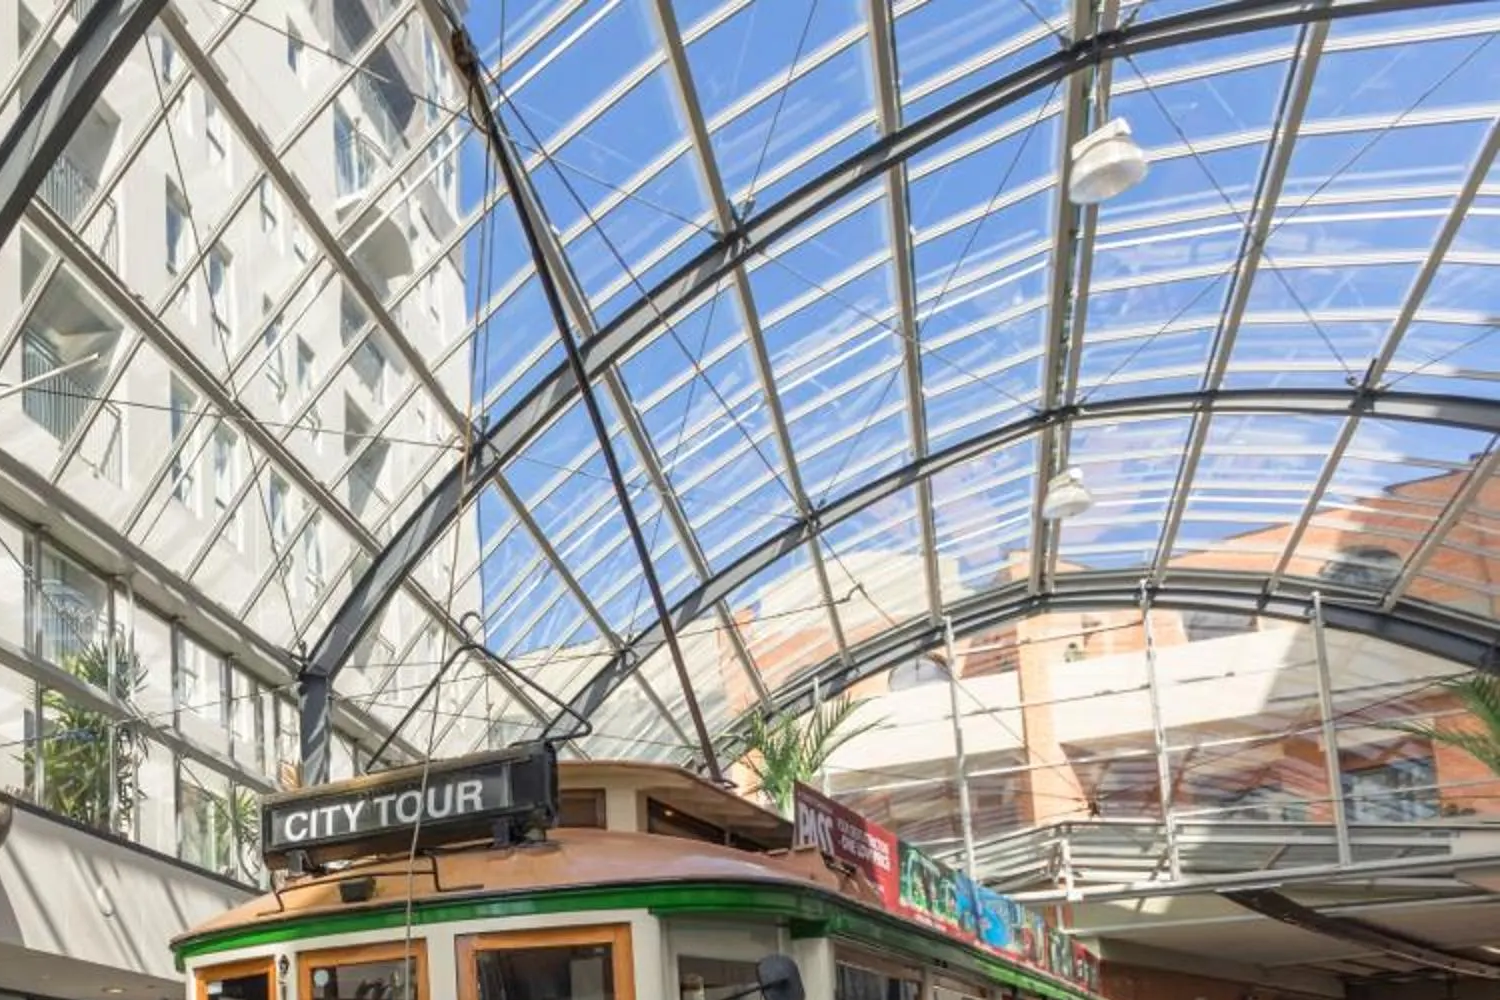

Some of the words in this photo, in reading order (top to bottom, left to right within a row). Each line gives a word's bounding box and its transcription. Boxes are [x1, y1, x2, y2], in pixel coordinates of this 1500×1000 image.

[285, 800, 365, 842] CITY
[373, 780, 483, 828] TOUR
[797, 801, 836, 857] PASS
